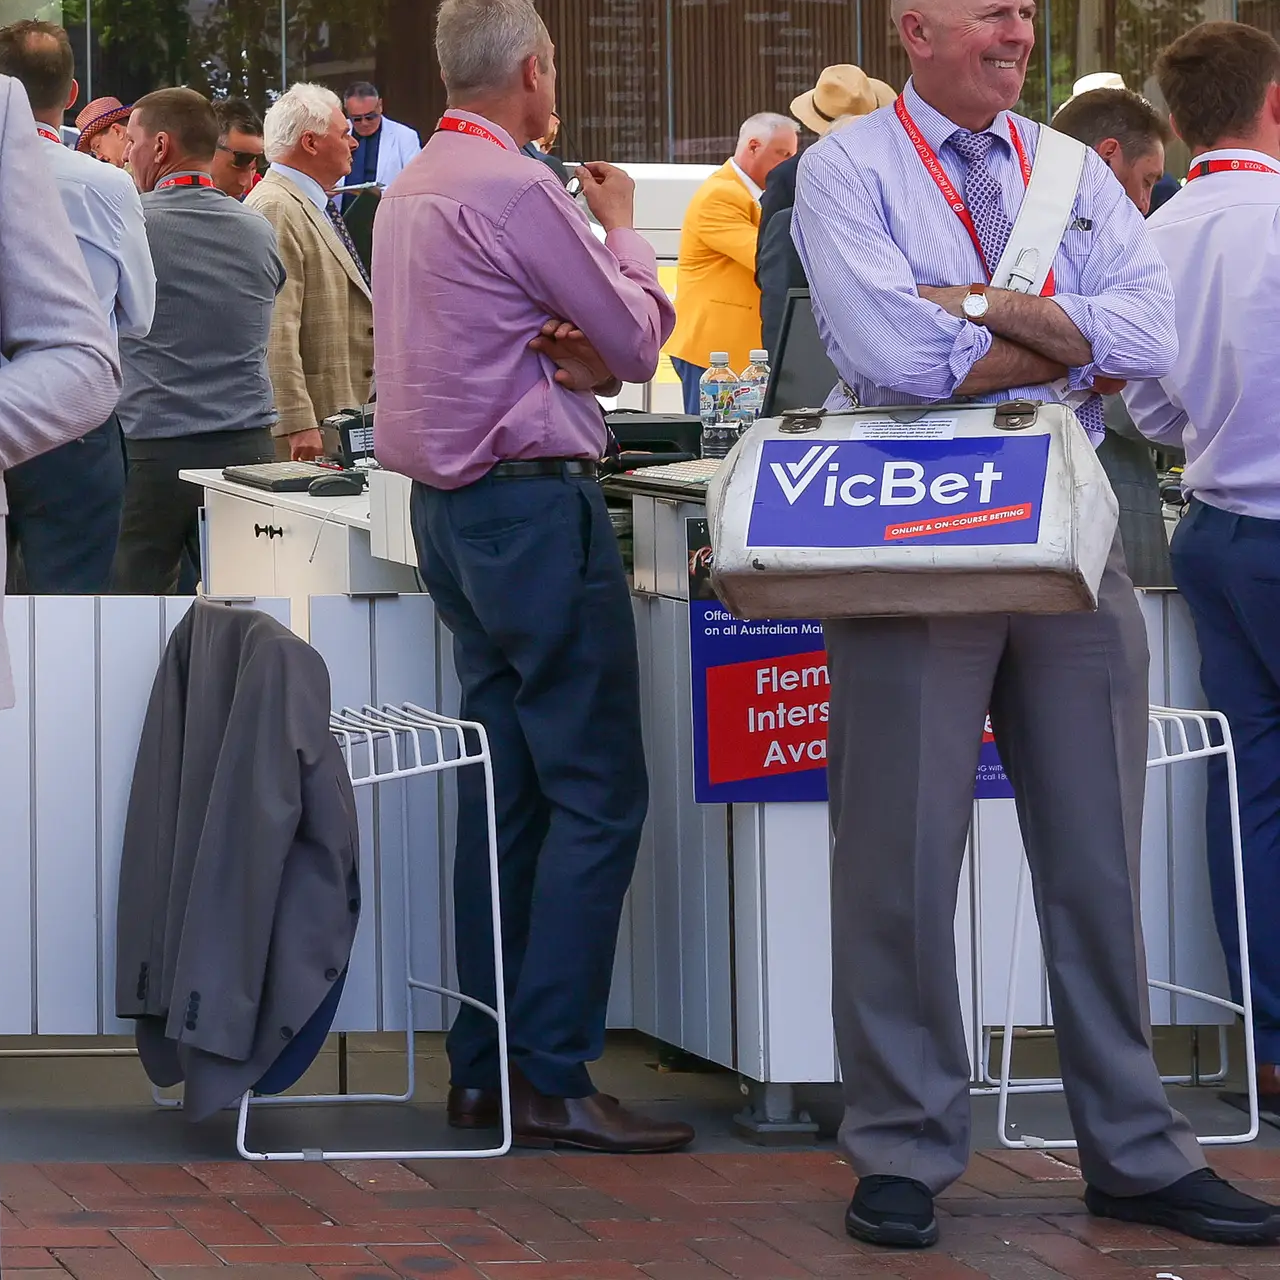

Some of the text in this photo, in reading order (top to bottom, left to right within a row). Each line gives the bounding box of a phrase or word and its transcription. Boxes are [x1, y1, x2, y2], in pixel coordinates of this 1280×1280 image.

[926, 156, 957, 201] MELBOURNE
[770, 446, 1002, 506] VicBet
[891, 525, 924, 535] ONLINE
[935, 515, 987, 529] ON-COURSE
[990, 508, 1024, 520] BETTING
[705, 624, 823, 635] on all Australian Mai
[757, 665, 830, 694] Flem
[748, 701, 829, 732] Inters
